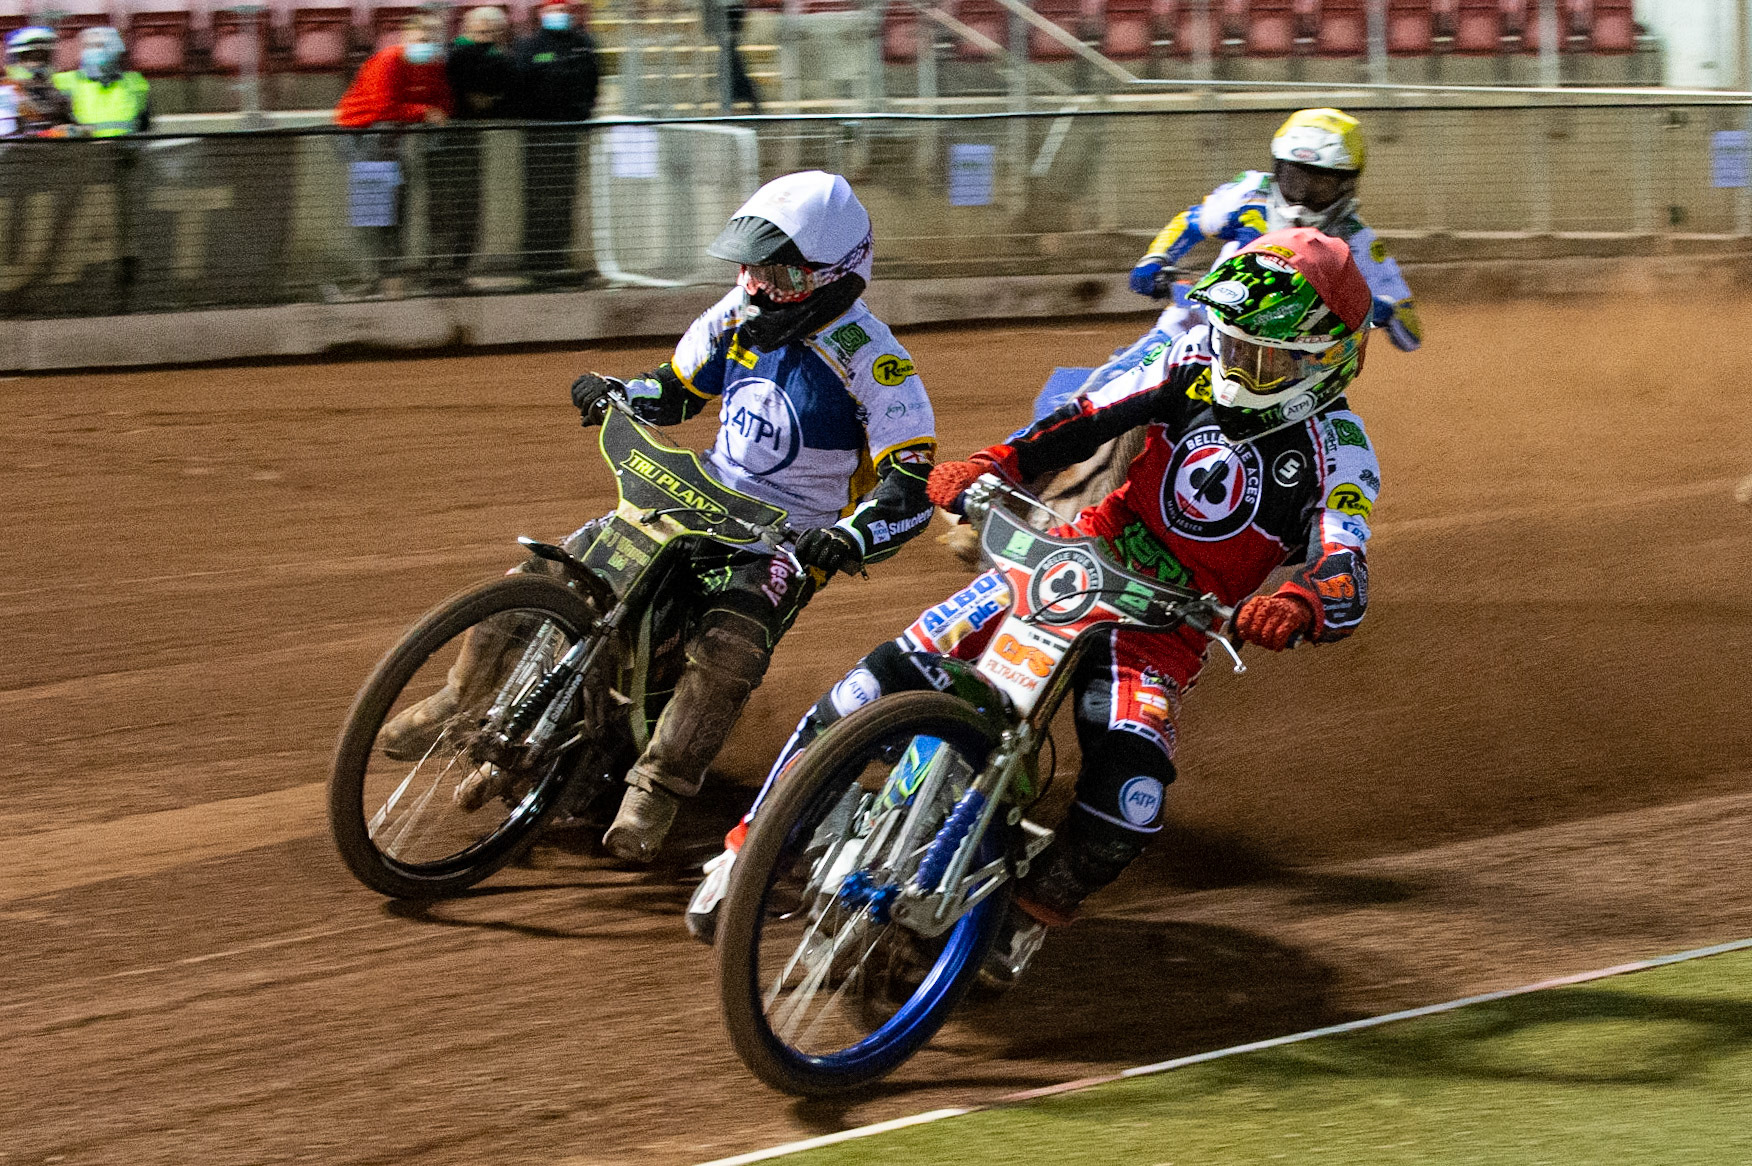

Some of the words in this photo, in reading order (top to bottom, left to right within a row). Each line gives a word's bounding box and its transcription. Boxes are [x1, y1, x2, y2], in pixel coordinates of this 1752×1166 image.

[1287, 400, 1311, 416] ATPI
[731, 406, 781, 451] ATPI
[628, 455, 661, 479] TRU
[1185, 432, 1228, 451] BELLE
[1244, 467, 1259, 504] ACES
[968, 600, 999, 630] plc
[986, 659, 1039, 690] FILTRATION
[551, 673, 584, 722] Silkolene
